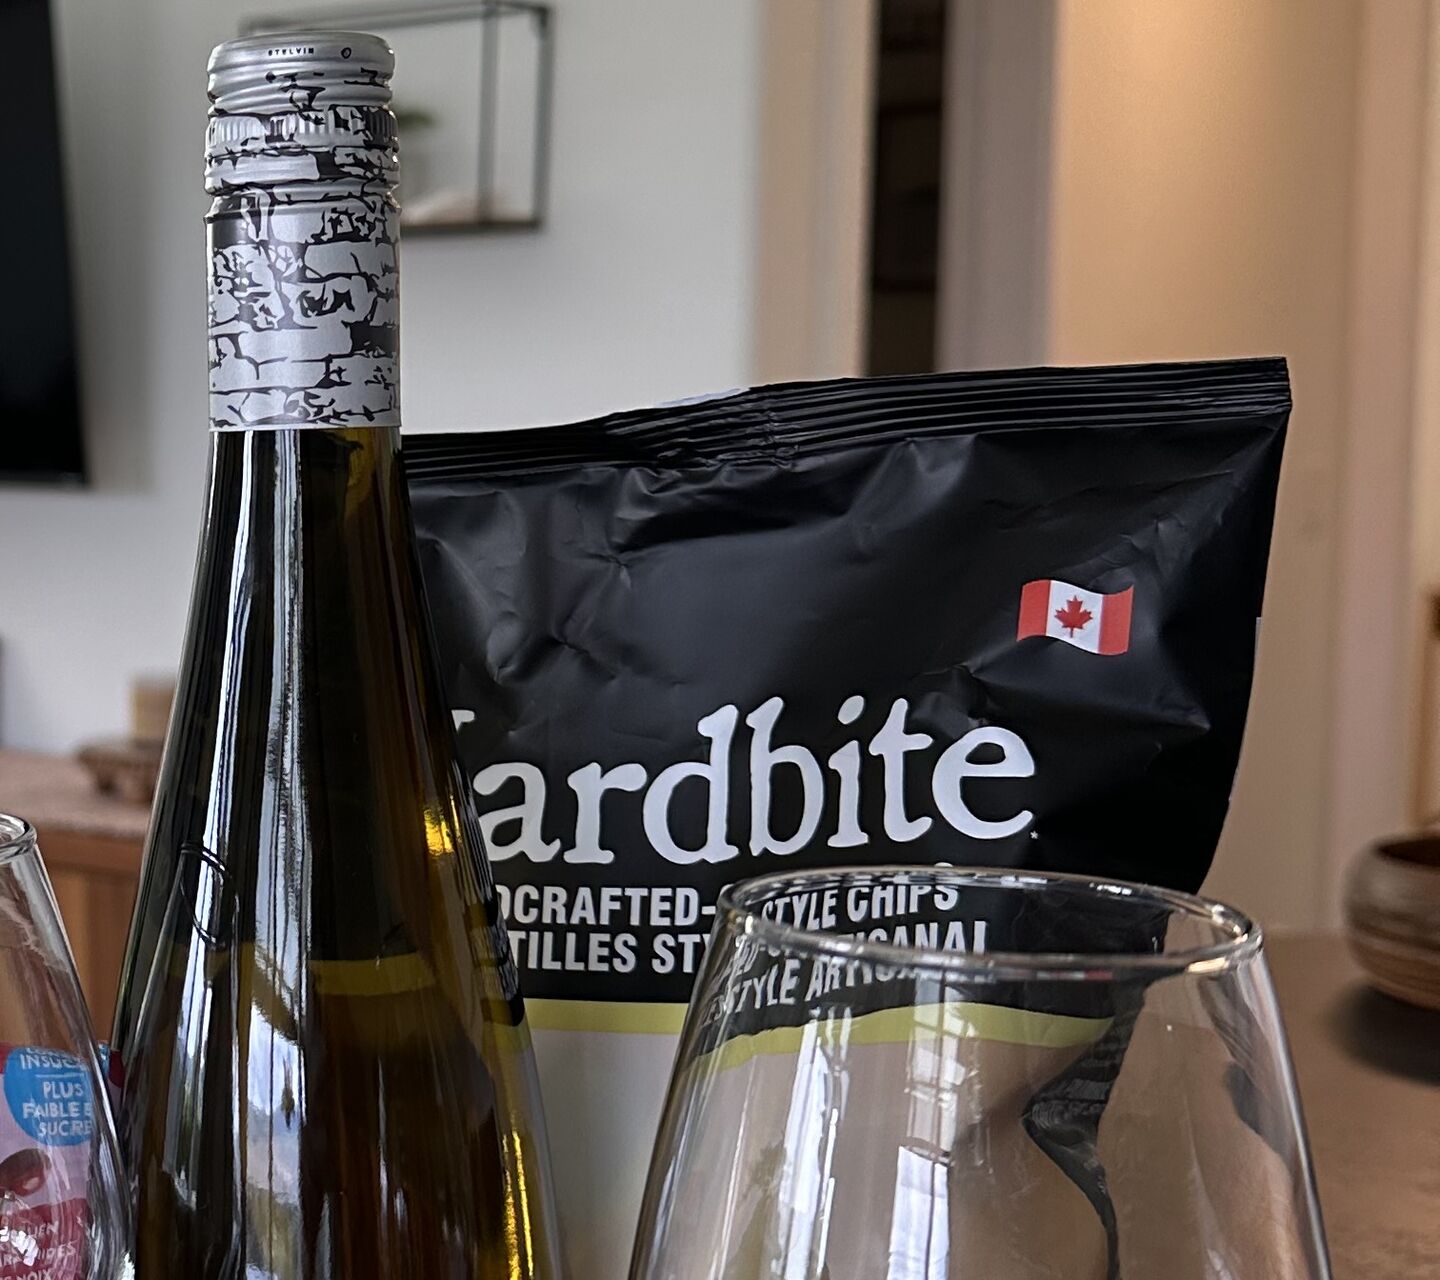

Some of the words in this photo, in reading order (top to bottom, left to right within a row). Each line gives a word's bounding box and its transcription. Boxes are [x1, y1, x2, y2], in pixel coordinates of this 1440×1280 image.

[453, 694, 1035, 865] ardbite
[847, 884, 959, 922] CHIPS
[512, 932, 638, 973] TILLES
[43, 1081, 84, 1099] PLUS
